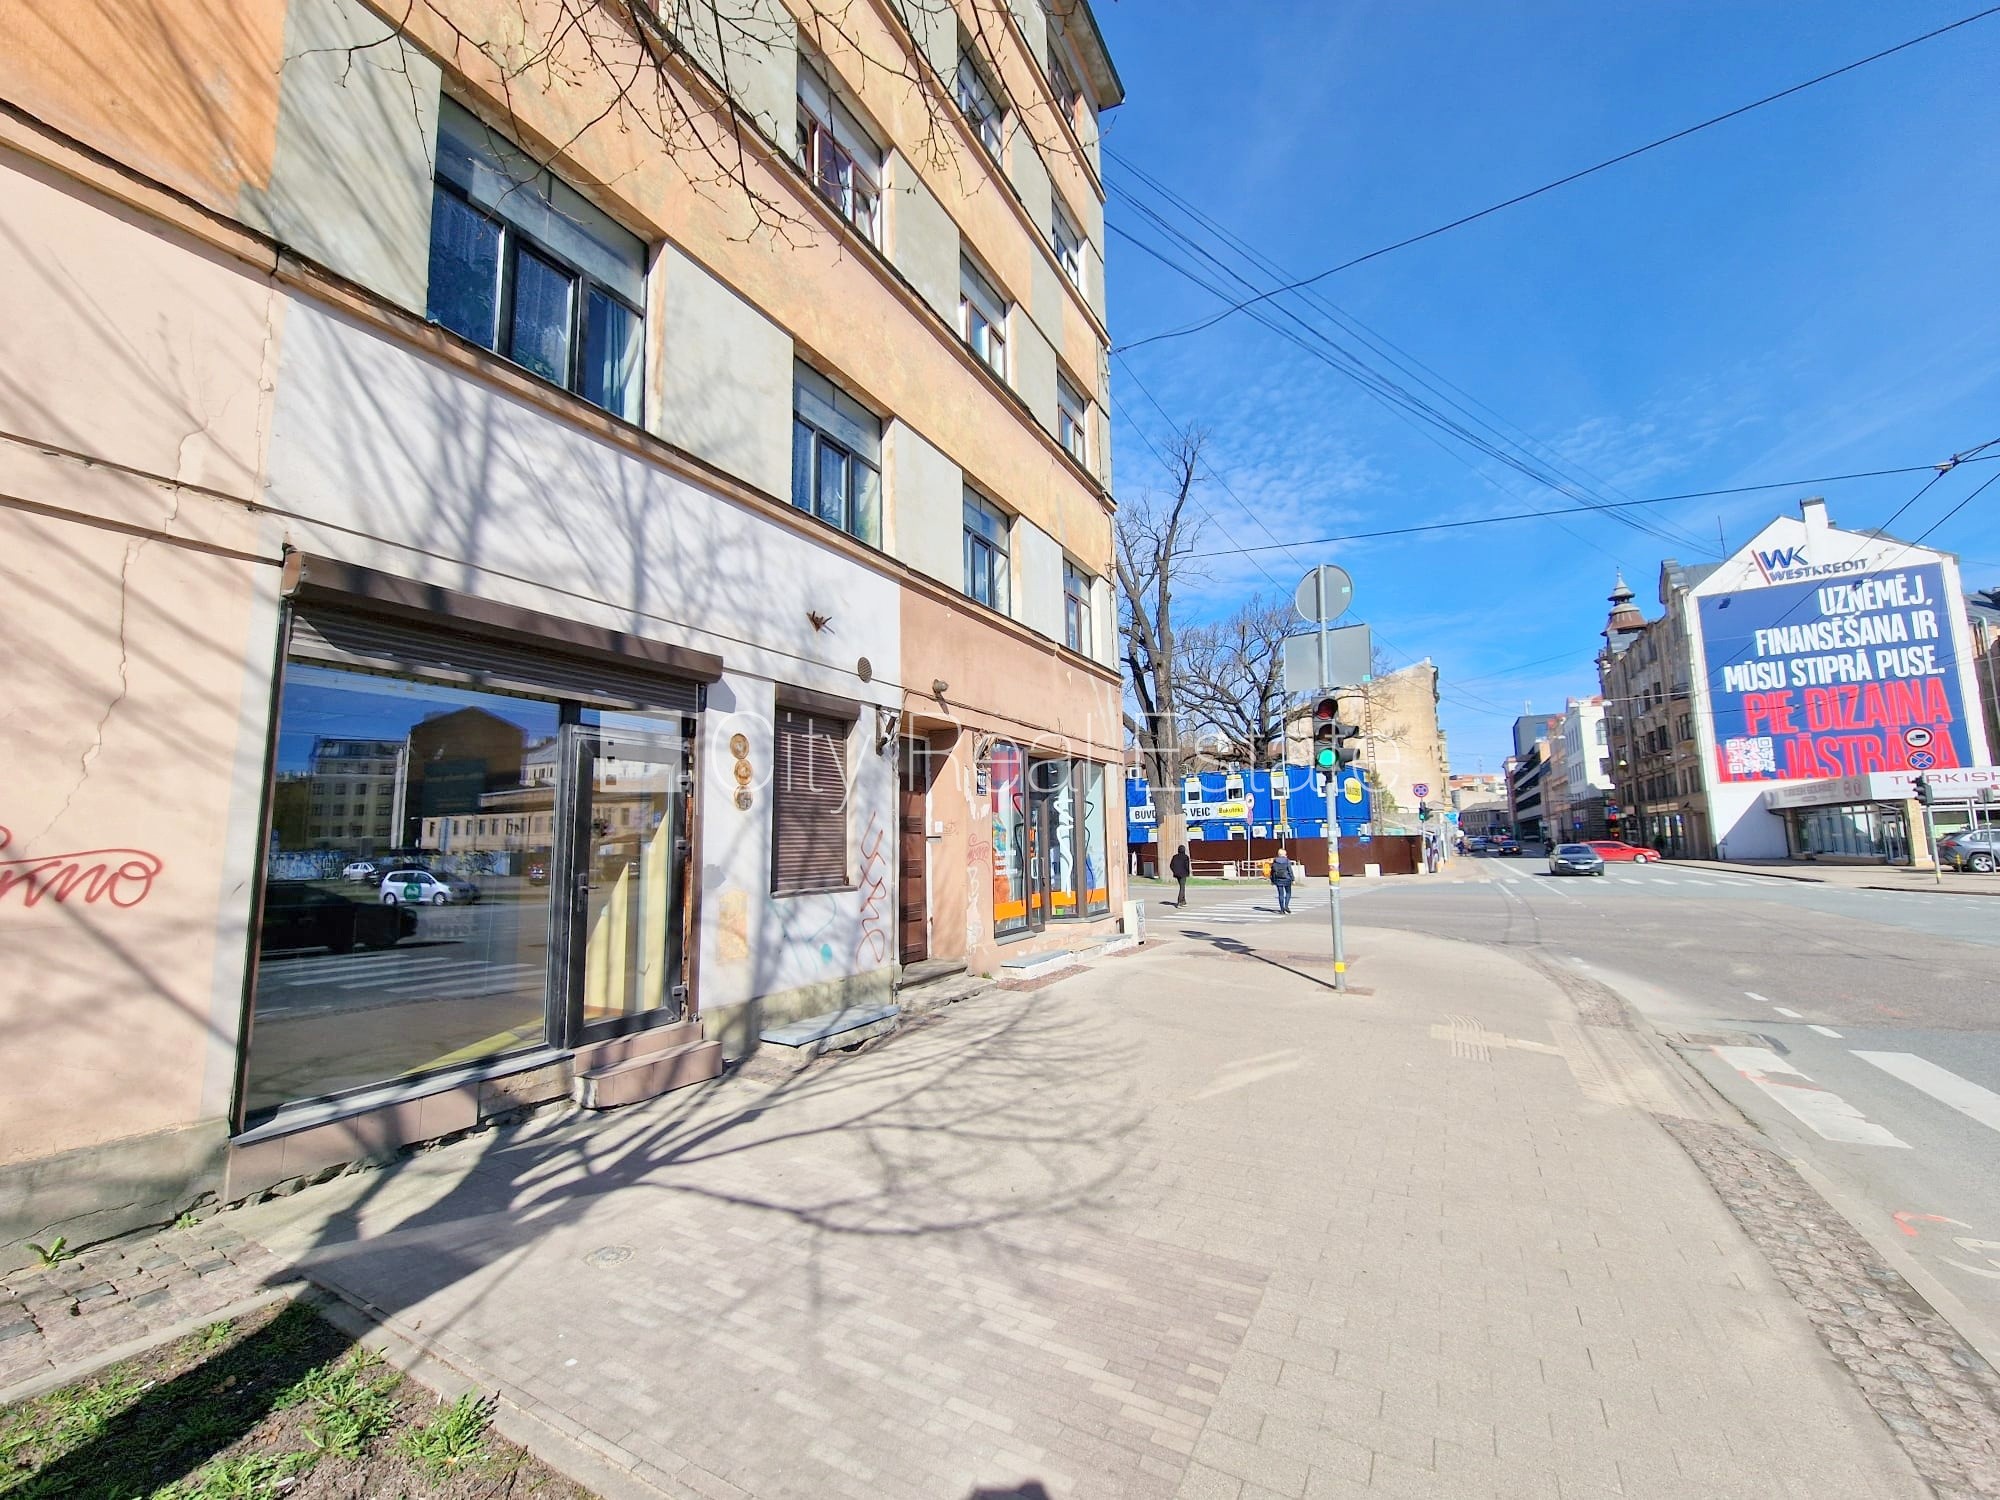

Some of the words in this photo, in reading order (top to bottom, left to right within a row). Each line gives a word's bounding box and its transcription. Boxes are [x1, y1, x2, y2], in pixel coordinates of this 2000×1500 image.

[1769, 558, 1869, 582] WESTKREDIT
[1755, 613, 1908, 657] FINANSĒŠANA
[1911, 609, 1939, 640] IR
[1723, 658, 1786, 693] MŪSU
[1791, 648, 1874, 685] STIPRĀ
[1877, 644, 1946, 678] PUSE.
[1743, 690, 1799, 736] PIE
[1804, 676, 1954, 733] DIZAINA
[1778, 724, 1960, 781] JĀSTRĀĀ
[1190, 806, 1211, 817] VEIC
